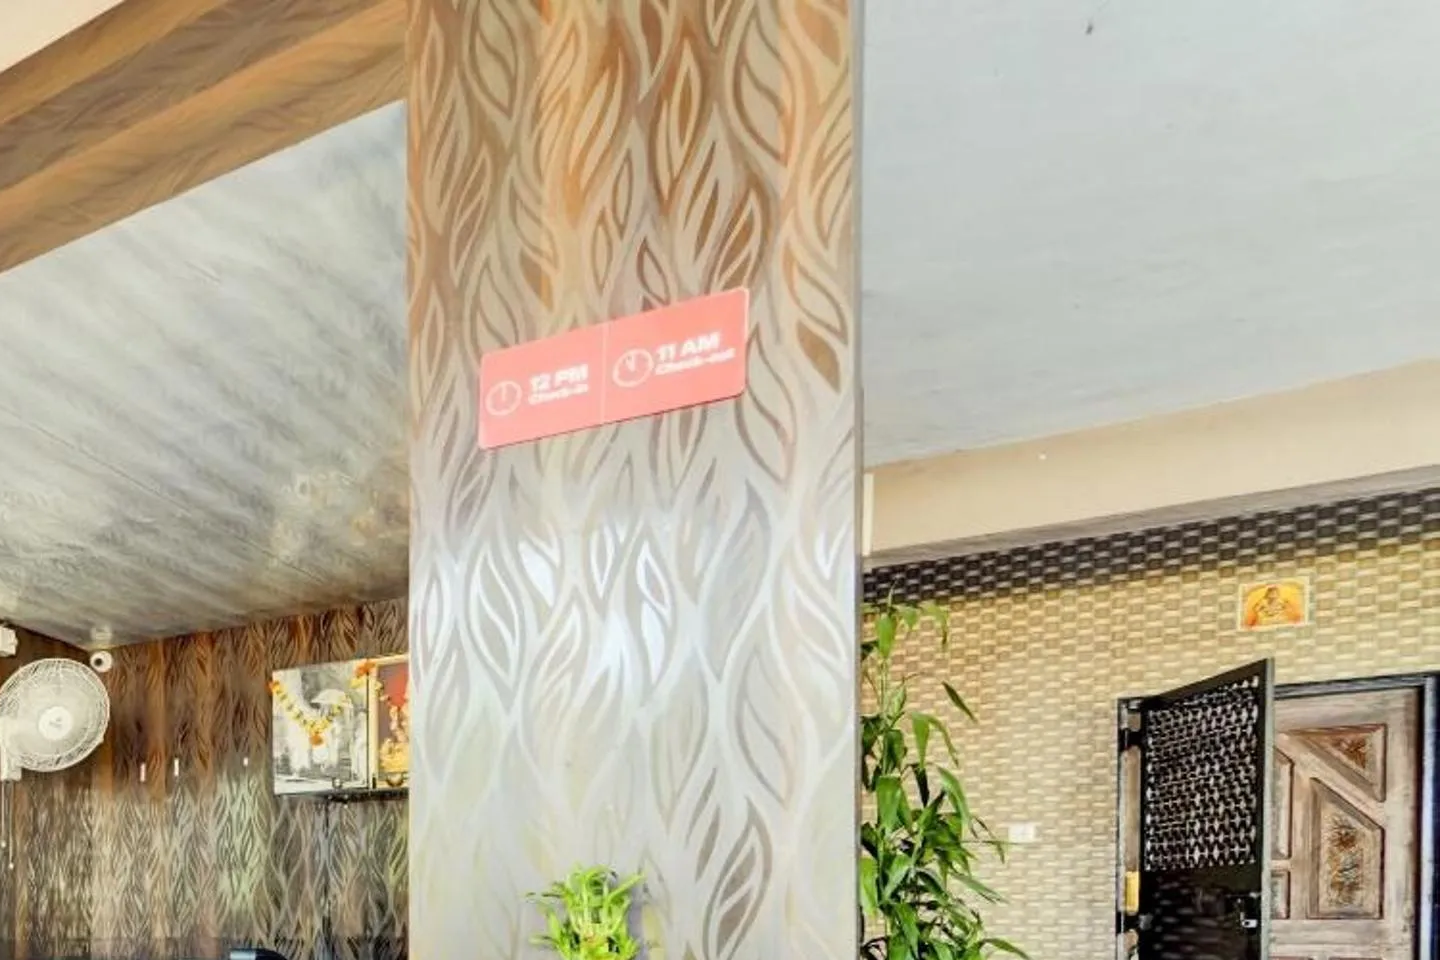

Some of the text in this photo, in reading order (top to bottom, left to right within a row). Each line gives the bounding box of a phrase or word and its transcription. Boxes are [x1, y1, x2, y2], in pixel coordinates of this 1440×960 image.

[656, 331, 720, 362] 11 AM
[529, 363, 589, 392] 12 PM
